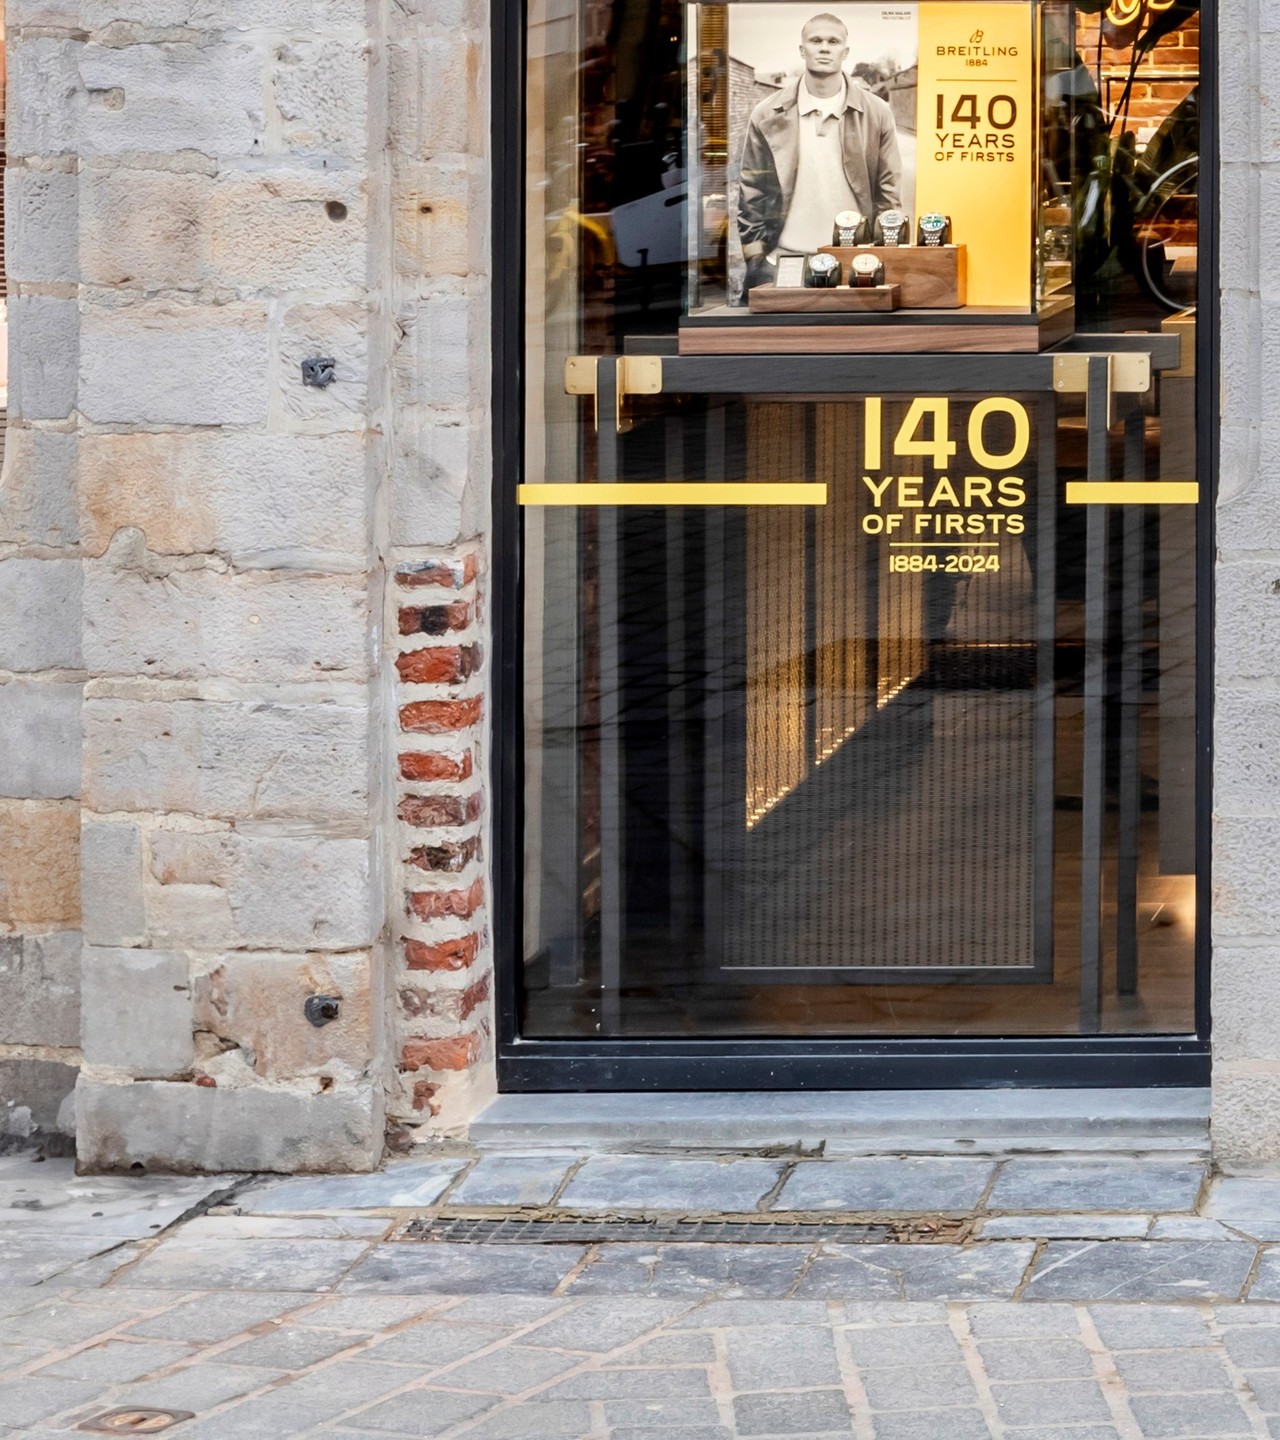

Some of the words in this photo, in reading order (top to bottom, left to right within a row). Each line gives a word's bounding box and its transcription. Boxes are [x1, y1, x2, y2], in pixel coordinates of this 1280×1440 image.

[936, 45, 1019, 57] BREITLING
[965, 59, 988, 67] 1884
[936, 94, 1018, 130] 140
[935, 133, 1016, 149] YEARS
[934, 151, 955, 162] OF
[960, 152, 1015, 163] FIRSTS
[864, 397, 1031, 471] 140
[862, 476, 1027, 508] YEARS
[862, 514, 904, 535] OF
[915, 514, 1026, 535] FIRSTS
[889, 554, 1001, 573] 1884-2024
